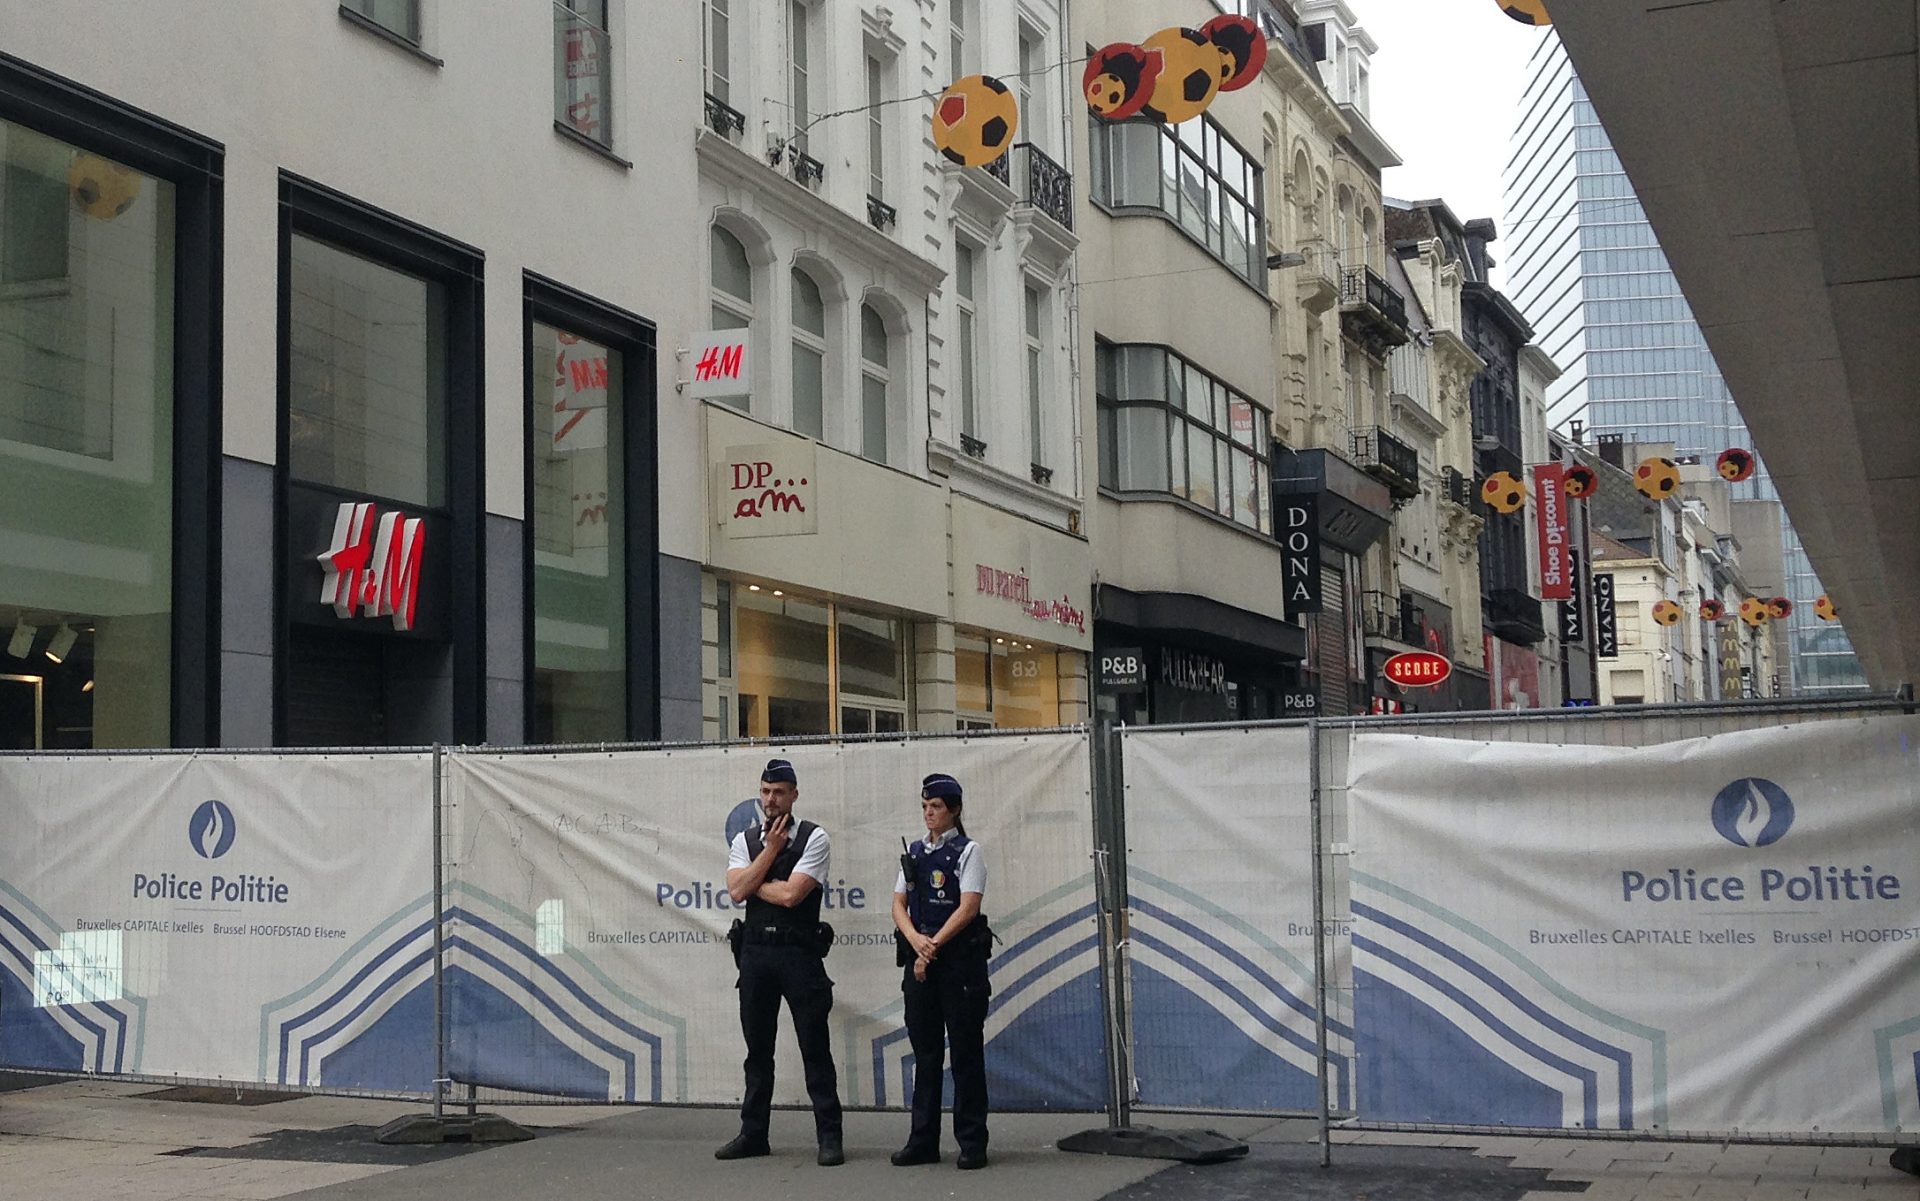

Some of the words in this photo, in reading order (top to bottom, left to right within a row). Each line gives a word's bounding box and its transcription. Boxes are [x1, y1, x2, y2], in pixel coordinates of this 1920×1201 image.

[696, 344, 743, 381] H&M
[734, 489, 805, 518] am
[1542, 478, 1565, 544] Discount
[317, 502, 426, 631] H&M
[1288, 507, 1310, 600] DONA
[1545, 546, 1561, 586] Shoe
[1600, 576, 1614, 653] MANO
[1102, 656, 1138, 675] P&B
[1394, 661, 1440, 677] SCORE
[1285, 694, 1316, 708] P&B
[133, 873, 202, 900] Police
[211, 875, 289, 903] Politie
[1621, 868, 1745, 902] Police
[1760, 865, 1900, 901] Politie
[76, 918, 122, 931] Bruxelles
[123, 920, 169, 932] CAPITALE
[172, 921, 204, 933] Ixelles
[213, 923, 246, 935] Brussel
[249, 925, 311, 938] HOOFDSTAD
[314, 927, 346, 938] Elsene
[587, 930, 646, 944] Bruxelles
[649, 930, 710, 944] CAPITALE
[1529, 928, 1608, 944] Bruxelles
[1612, 929, 1692, 944] CAPITALE
[1700, 928, 1755, 944] Ixelles
[1773, 929, 1833, 944] Brussel
